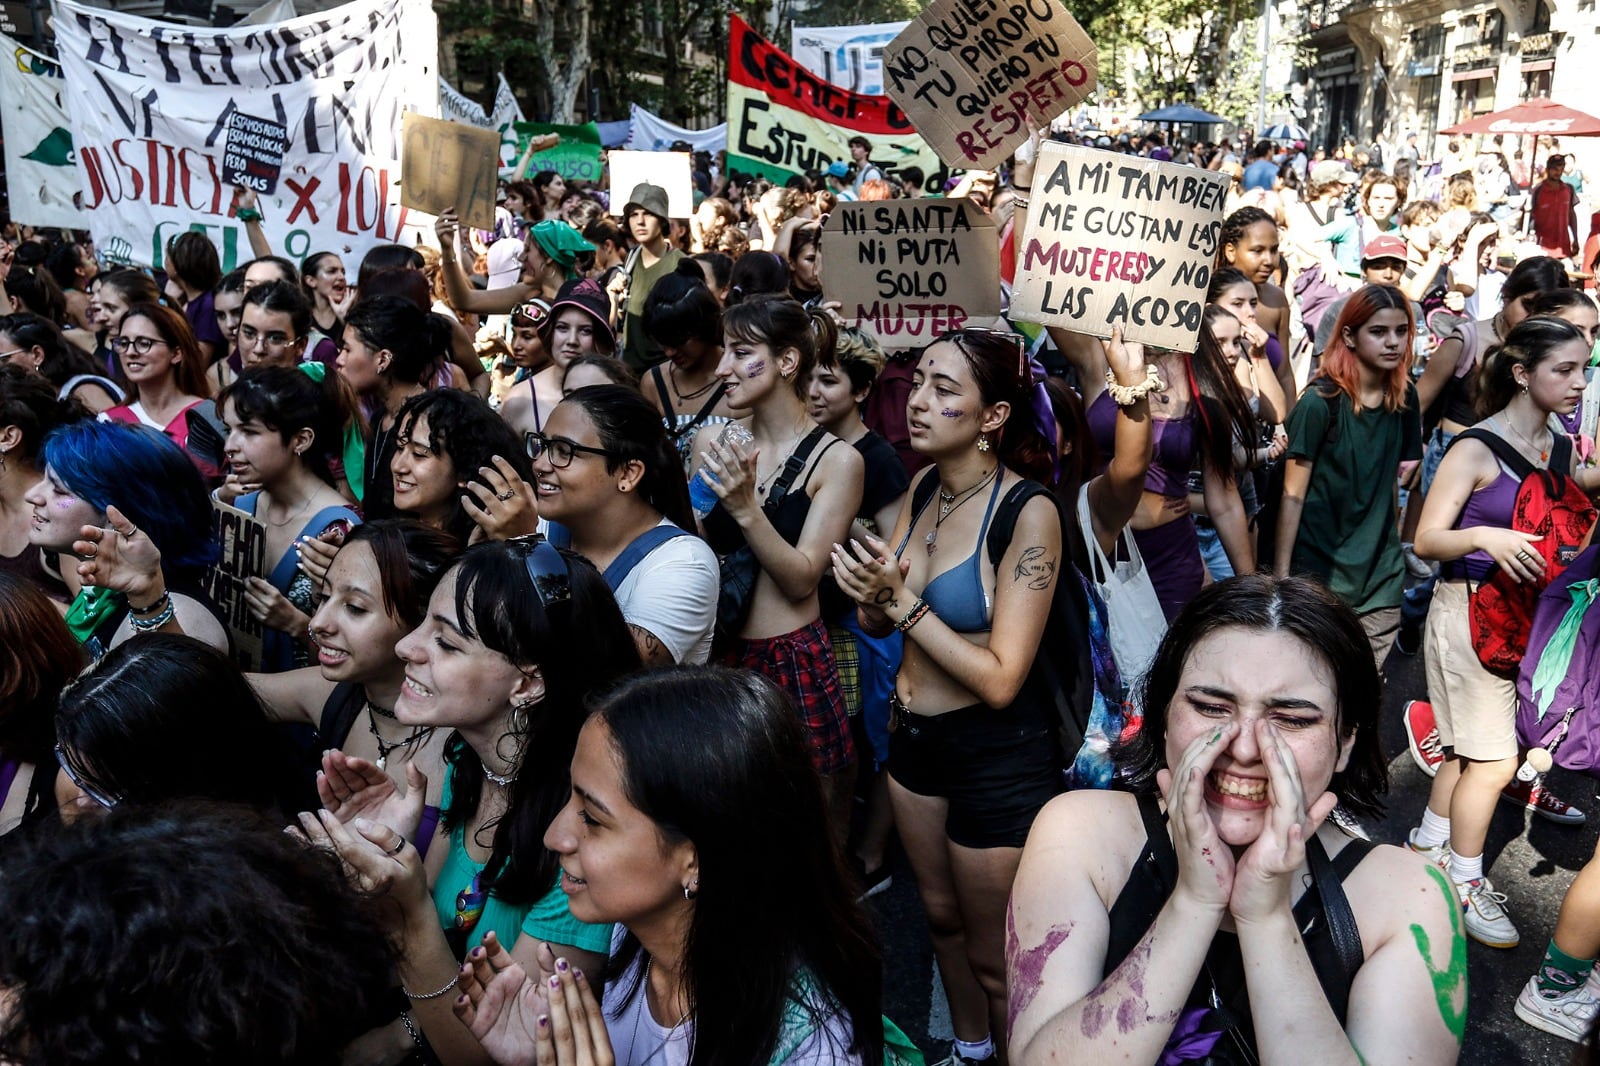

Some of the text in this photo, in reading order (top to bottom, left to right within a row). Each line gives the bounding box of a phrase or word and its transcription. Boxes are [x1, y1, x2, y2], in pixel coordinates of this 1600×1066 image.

[1023, 33, 1060, 63] TU
[886, 46, 929, 94] NO
[914, 69, 957, 109] TU
[230, 112, 285, 139] ESTAMOS ROTAS
[956, 60, 1088, 162] RESPETO
[228, 127, 284, 155] ESTAMOS LOCAS
[225, 153, 247, 172] PERO
[529, 160, 594, 178] ABUSO
[1043, 159, 1072, 196] A
[231, 172, 268, 192] SOLAS
[874, 203, 971, 235] SANTA
[1039, 202, 1221, 257] ME GUSTAN LAS
[897, 237, 961, 266] PUTA
[1023, 238, 1210, 289] MUJERES Y NO
[876, 269, 947, 299] SOLO
[856, 301, 969, 337] MUJER
[1040, 281, 1202, 332] LAS ACOSO
